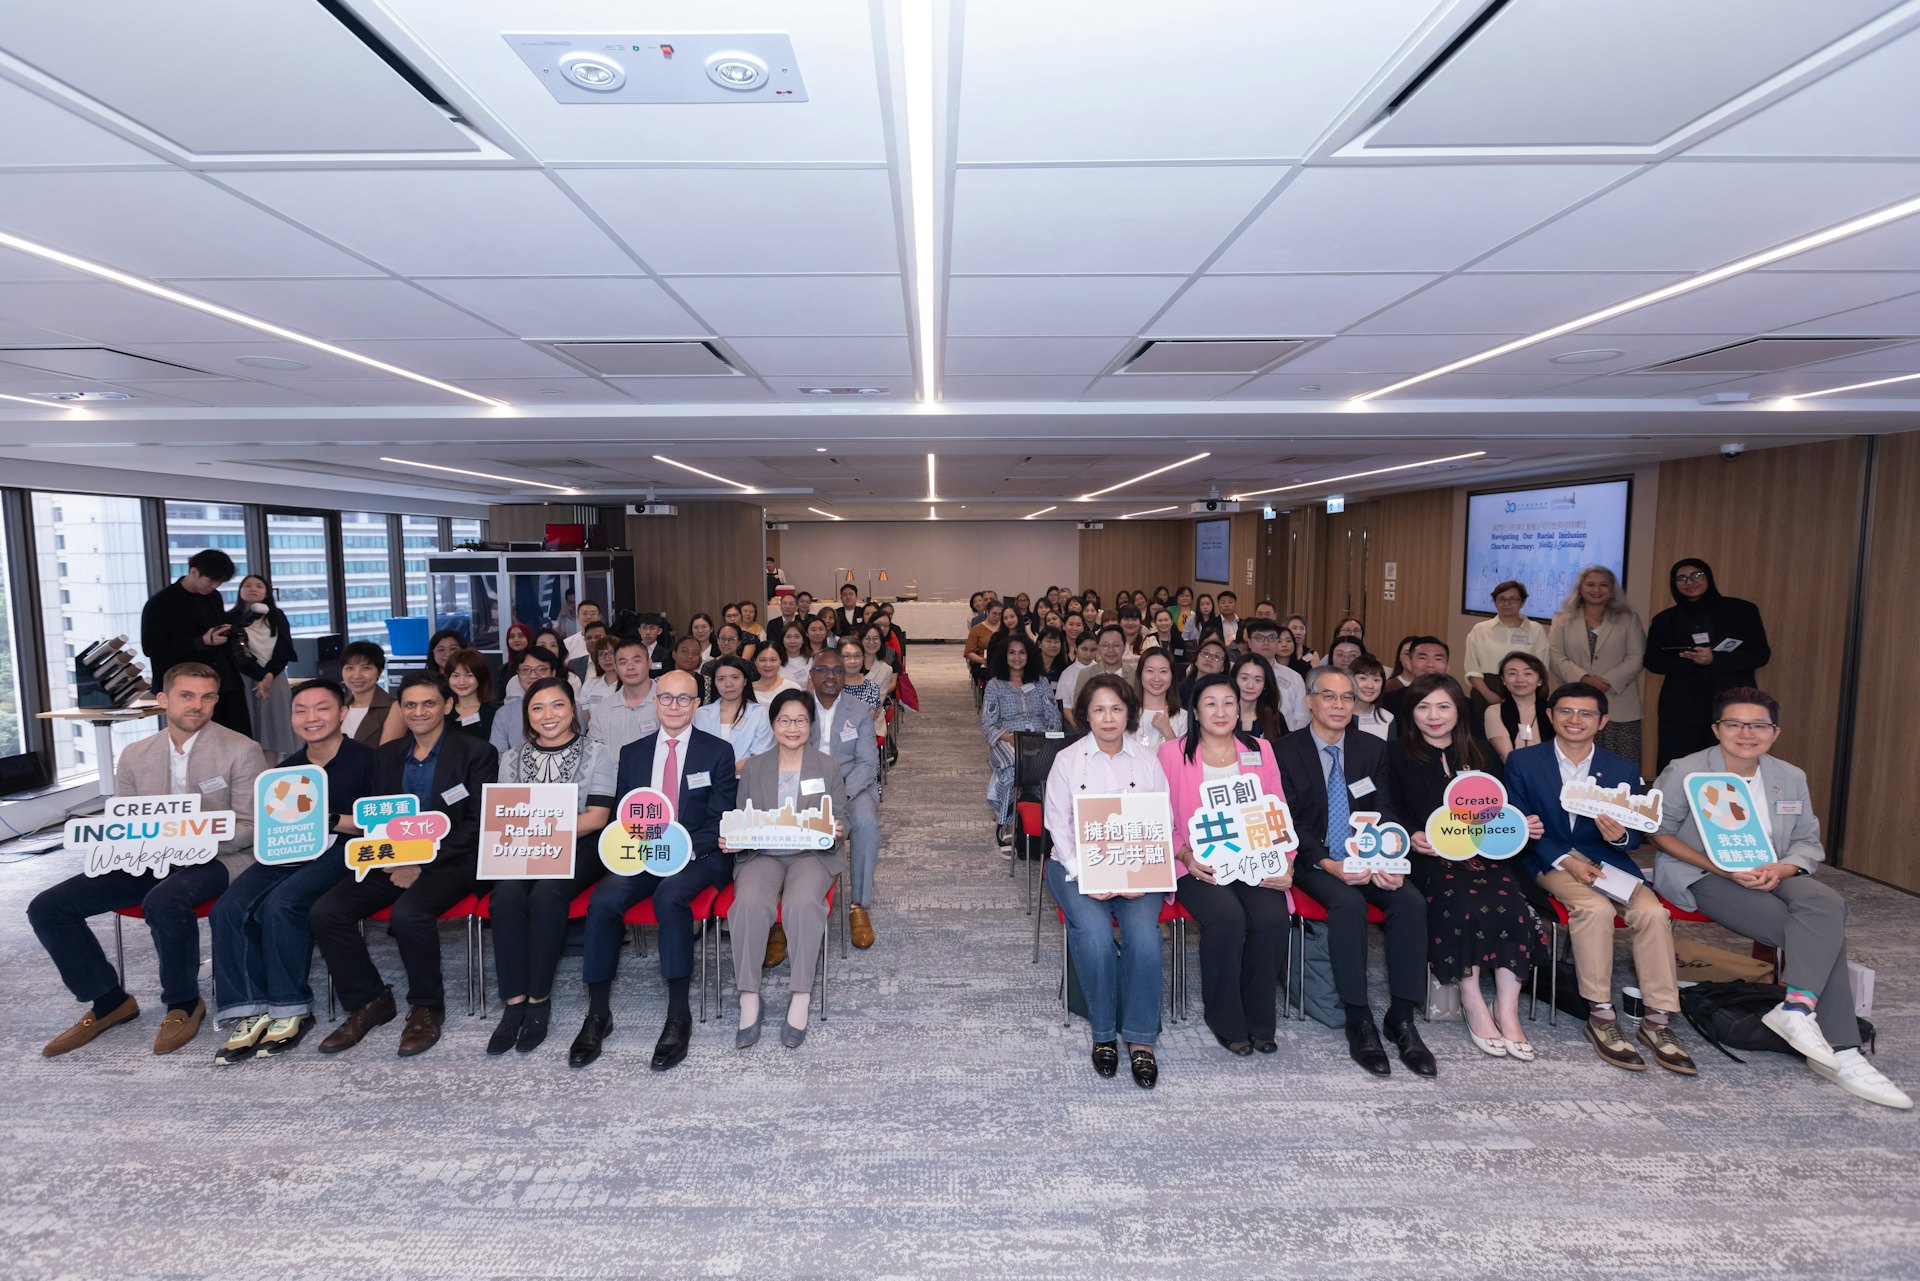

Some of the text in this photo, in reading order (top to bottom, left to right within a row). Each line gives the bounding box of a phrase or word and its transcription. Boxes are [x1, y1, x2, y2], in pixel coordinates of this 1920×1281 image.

[1492, 533, 1519, 541] Navigating
[1207, 779, 1257, 810] 同創
[1455, 796, 1498, 806] Create
[113, 801, 192, 816] CREATE
[362, 801, 410, 817] 我尊重
[495, 804, 564, 818] Embrace
[630, 803, 662, 820] 同創
[1450, 810, 1505, 821] Inclusive
[74, 818, 227, 842] INCLUSIVE
[273, 822, 315, 834] SUPPORT
[399, 819, 435, 837] 文化
[505, 823, 552, 837] Racial
[629, 823, 662, 840] 共融
[1084, 821, 1164, 841] 擁抱種族
[1195, 802, 1292, 858] 共融
[1441, 824, 1516, 837] Workplaces
[267, 832, 316, 847] RACIAL
[1717, 833, 1756, 847] 我支持
[90, 840, 212, 873] Workspace
[267, 844, 315, 857] EQUALITY
[357, 843, 395, 862] 差異
[492, 843, 563, 860] Diversity
[620, 844, 670, 861] 工作間
[1087, 843, 1166, 866] 多元共融
[1717, 849, 1769, 862] 種族平等
